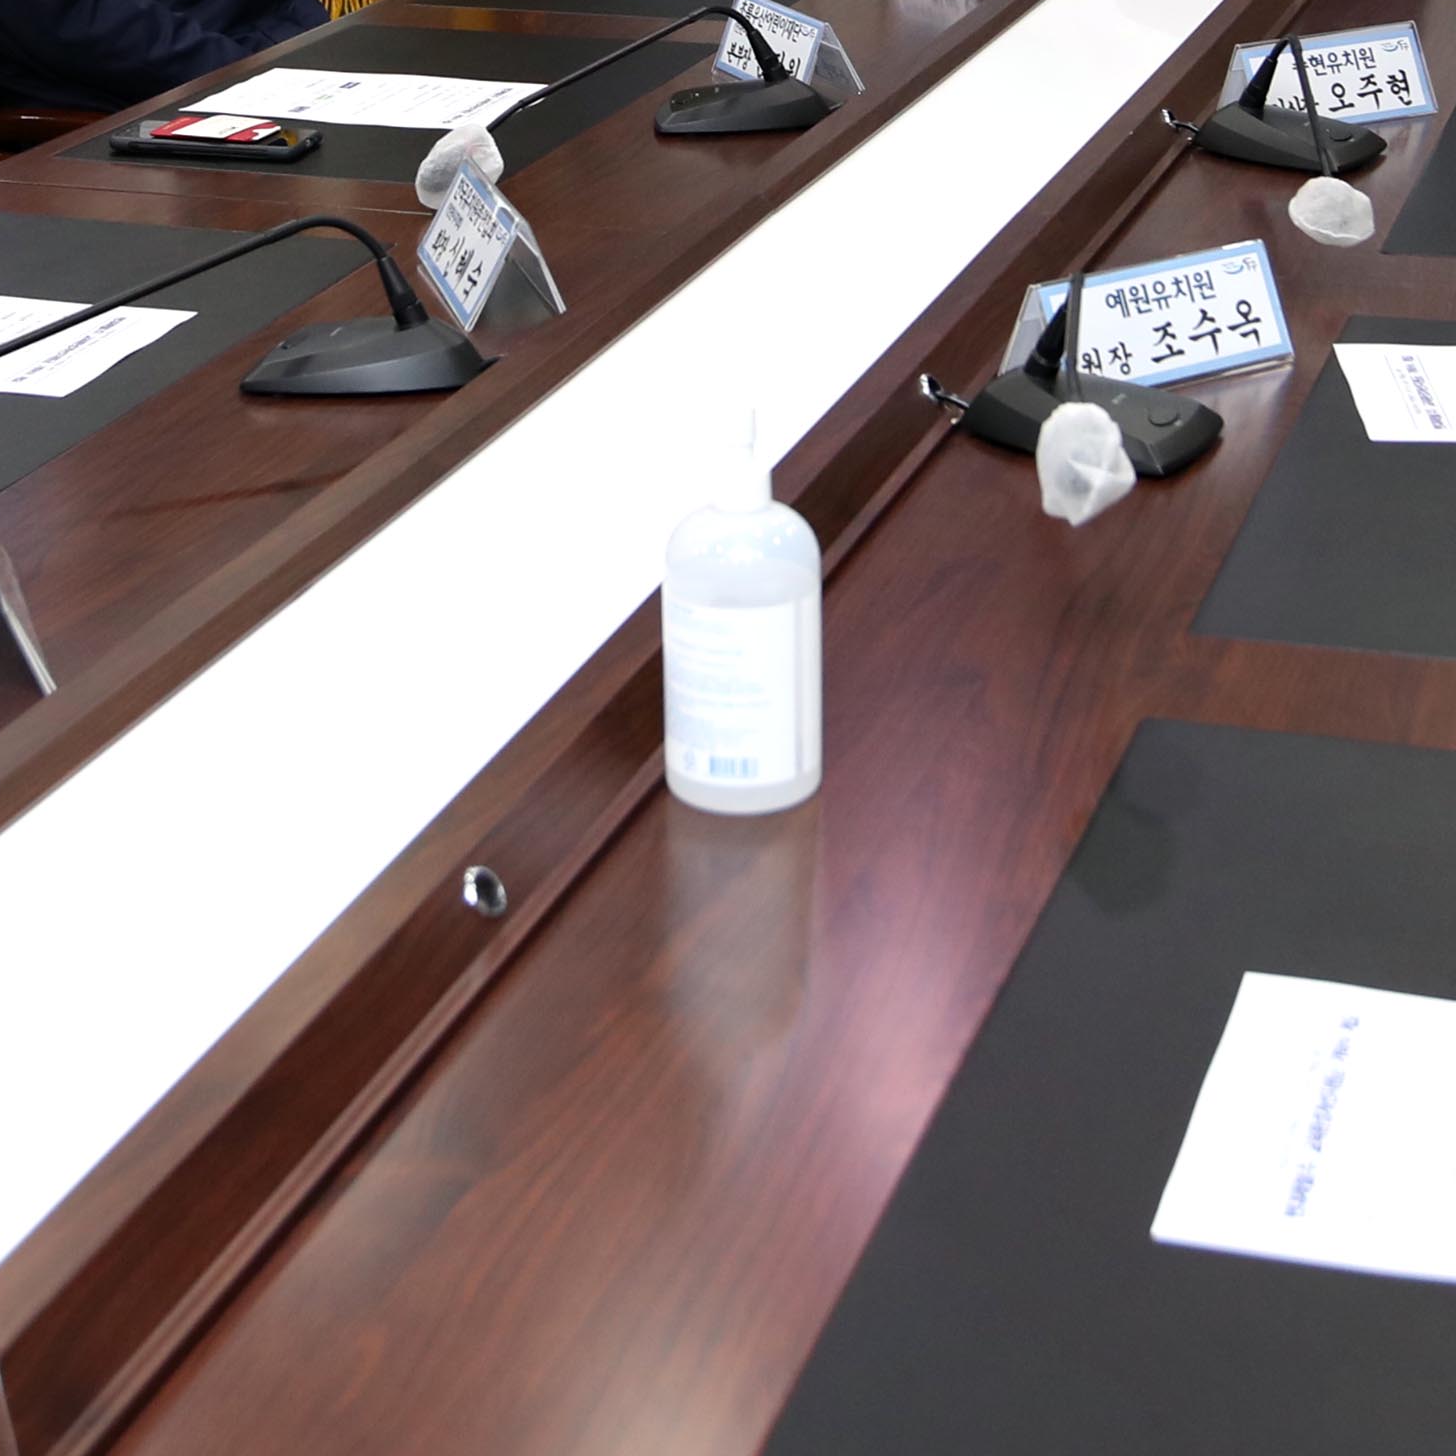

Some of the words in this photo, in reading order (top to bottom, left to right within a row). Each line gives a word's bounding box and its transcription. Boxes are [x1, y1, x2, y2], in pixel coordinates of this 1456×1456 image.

[1328, 69, 1413, 113] 오주현
[1105, 270, 1217, 319] 예원유치원
[1151, 299, 1262, 364] 조수옥
